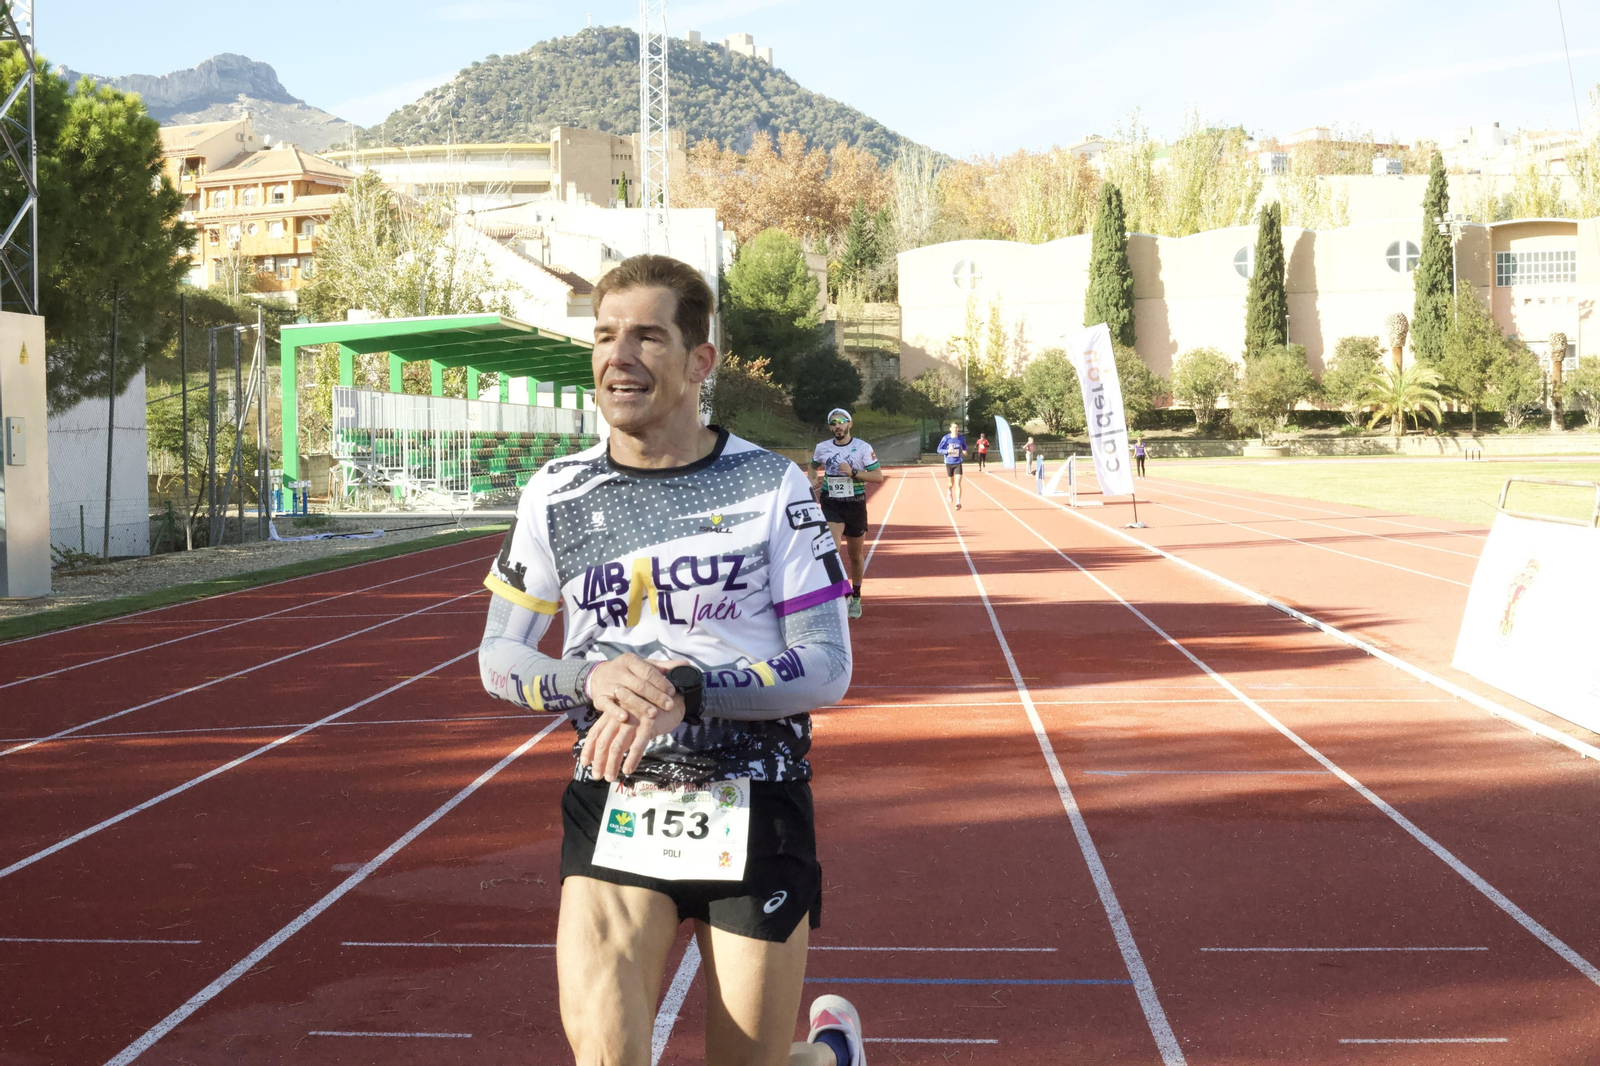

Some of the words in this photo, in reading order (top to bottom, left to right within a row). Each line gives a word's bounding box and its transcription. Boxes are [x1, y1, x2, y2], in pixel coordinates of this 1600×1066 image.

[698, 526, 733, 534] SPALL
[587, 583, 689, 629] TRAIL
[688, 594, 743, 634] Jaén
[684, 782, 712, 793] PUEES
[641, 808, 710, 840] 153
[663, 849, 682, 858] POLI
